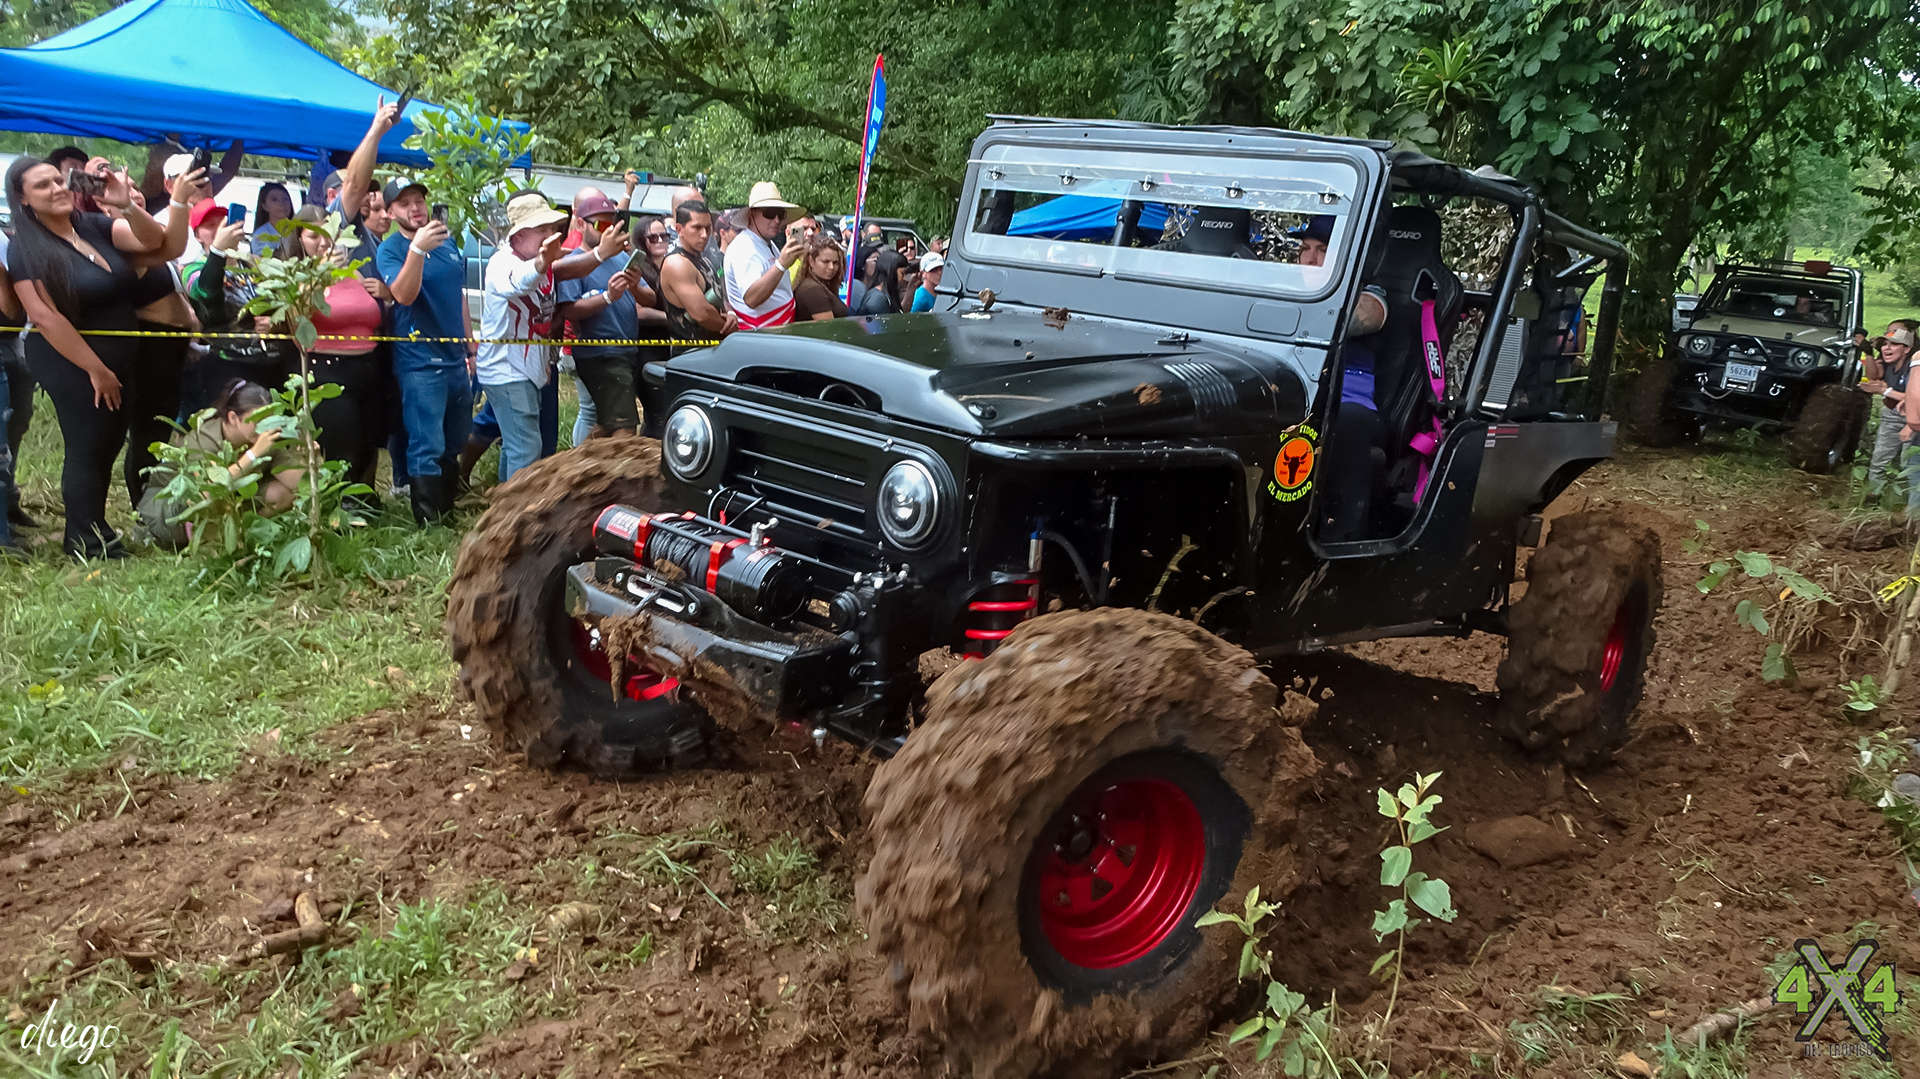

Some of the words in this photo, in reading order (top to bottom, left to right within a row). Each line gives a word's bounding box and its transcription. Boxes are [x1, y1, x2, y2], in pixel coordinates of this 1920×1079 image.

[1200, 220, 1234, 229] RECARO
[1388, 229, 1422, 240] ECARO
[1426, 341, 1442, 378] PRP
[1267, 480, 1276, 496] EL
[1275, 480, 1313, 502] MERCADO
